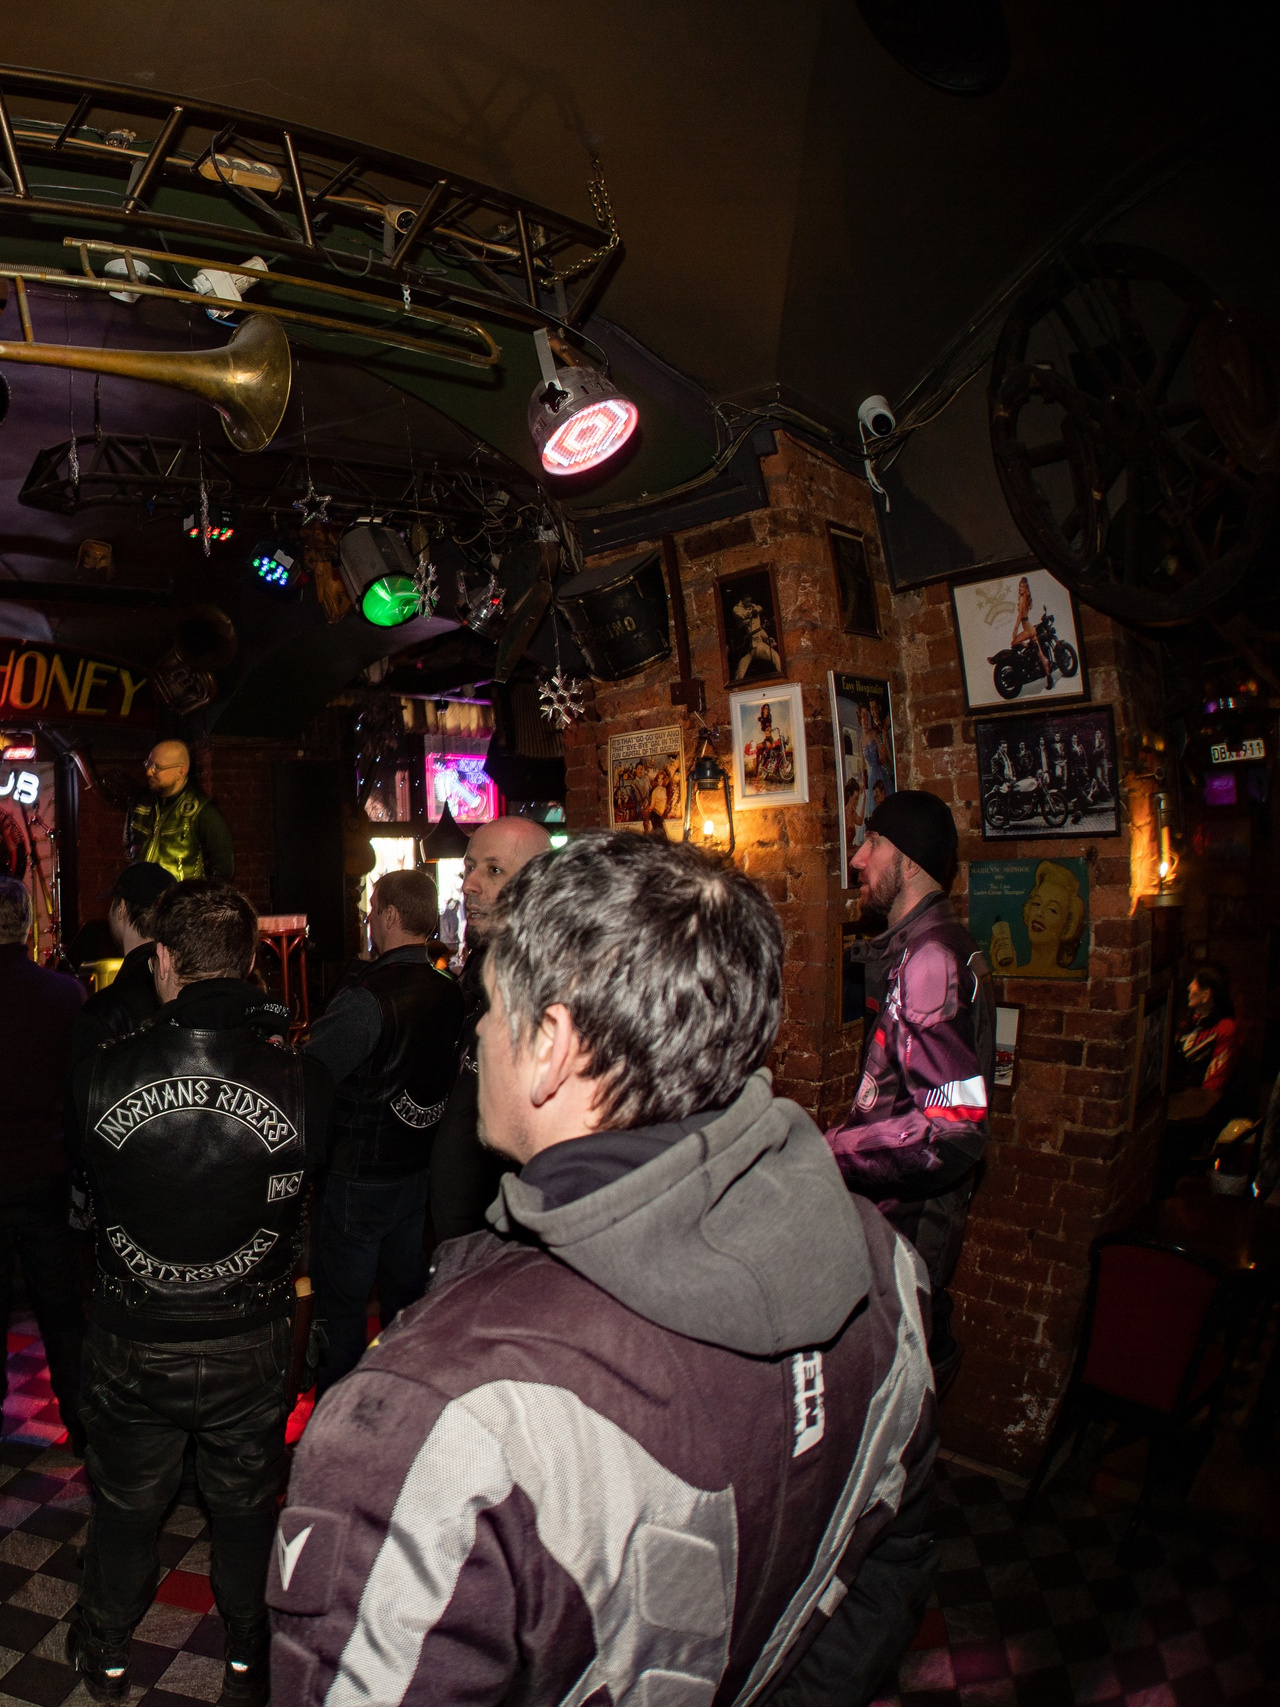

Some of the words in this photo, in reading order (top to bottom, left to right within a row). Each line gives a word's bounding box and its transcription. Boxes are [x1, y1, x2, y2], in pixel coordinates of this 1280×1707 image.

[612, 744, 624, 753] THAT
[669, 736, 680, 744] THE
[621, 736, 634, 746] THAT
[655, 732, 667, 741] GUY
[666, 730, 680, 739] AND
[621, 749, 642, 758] CAPITAL
[641, 747, 649, 755] OF
[649, 746, 659, 754] THE
[101, 1079, 211, 1142] NORMANS
[215, 1084, 289, 1142] RIDERS
[271, 1174, 299, 1199] MC
